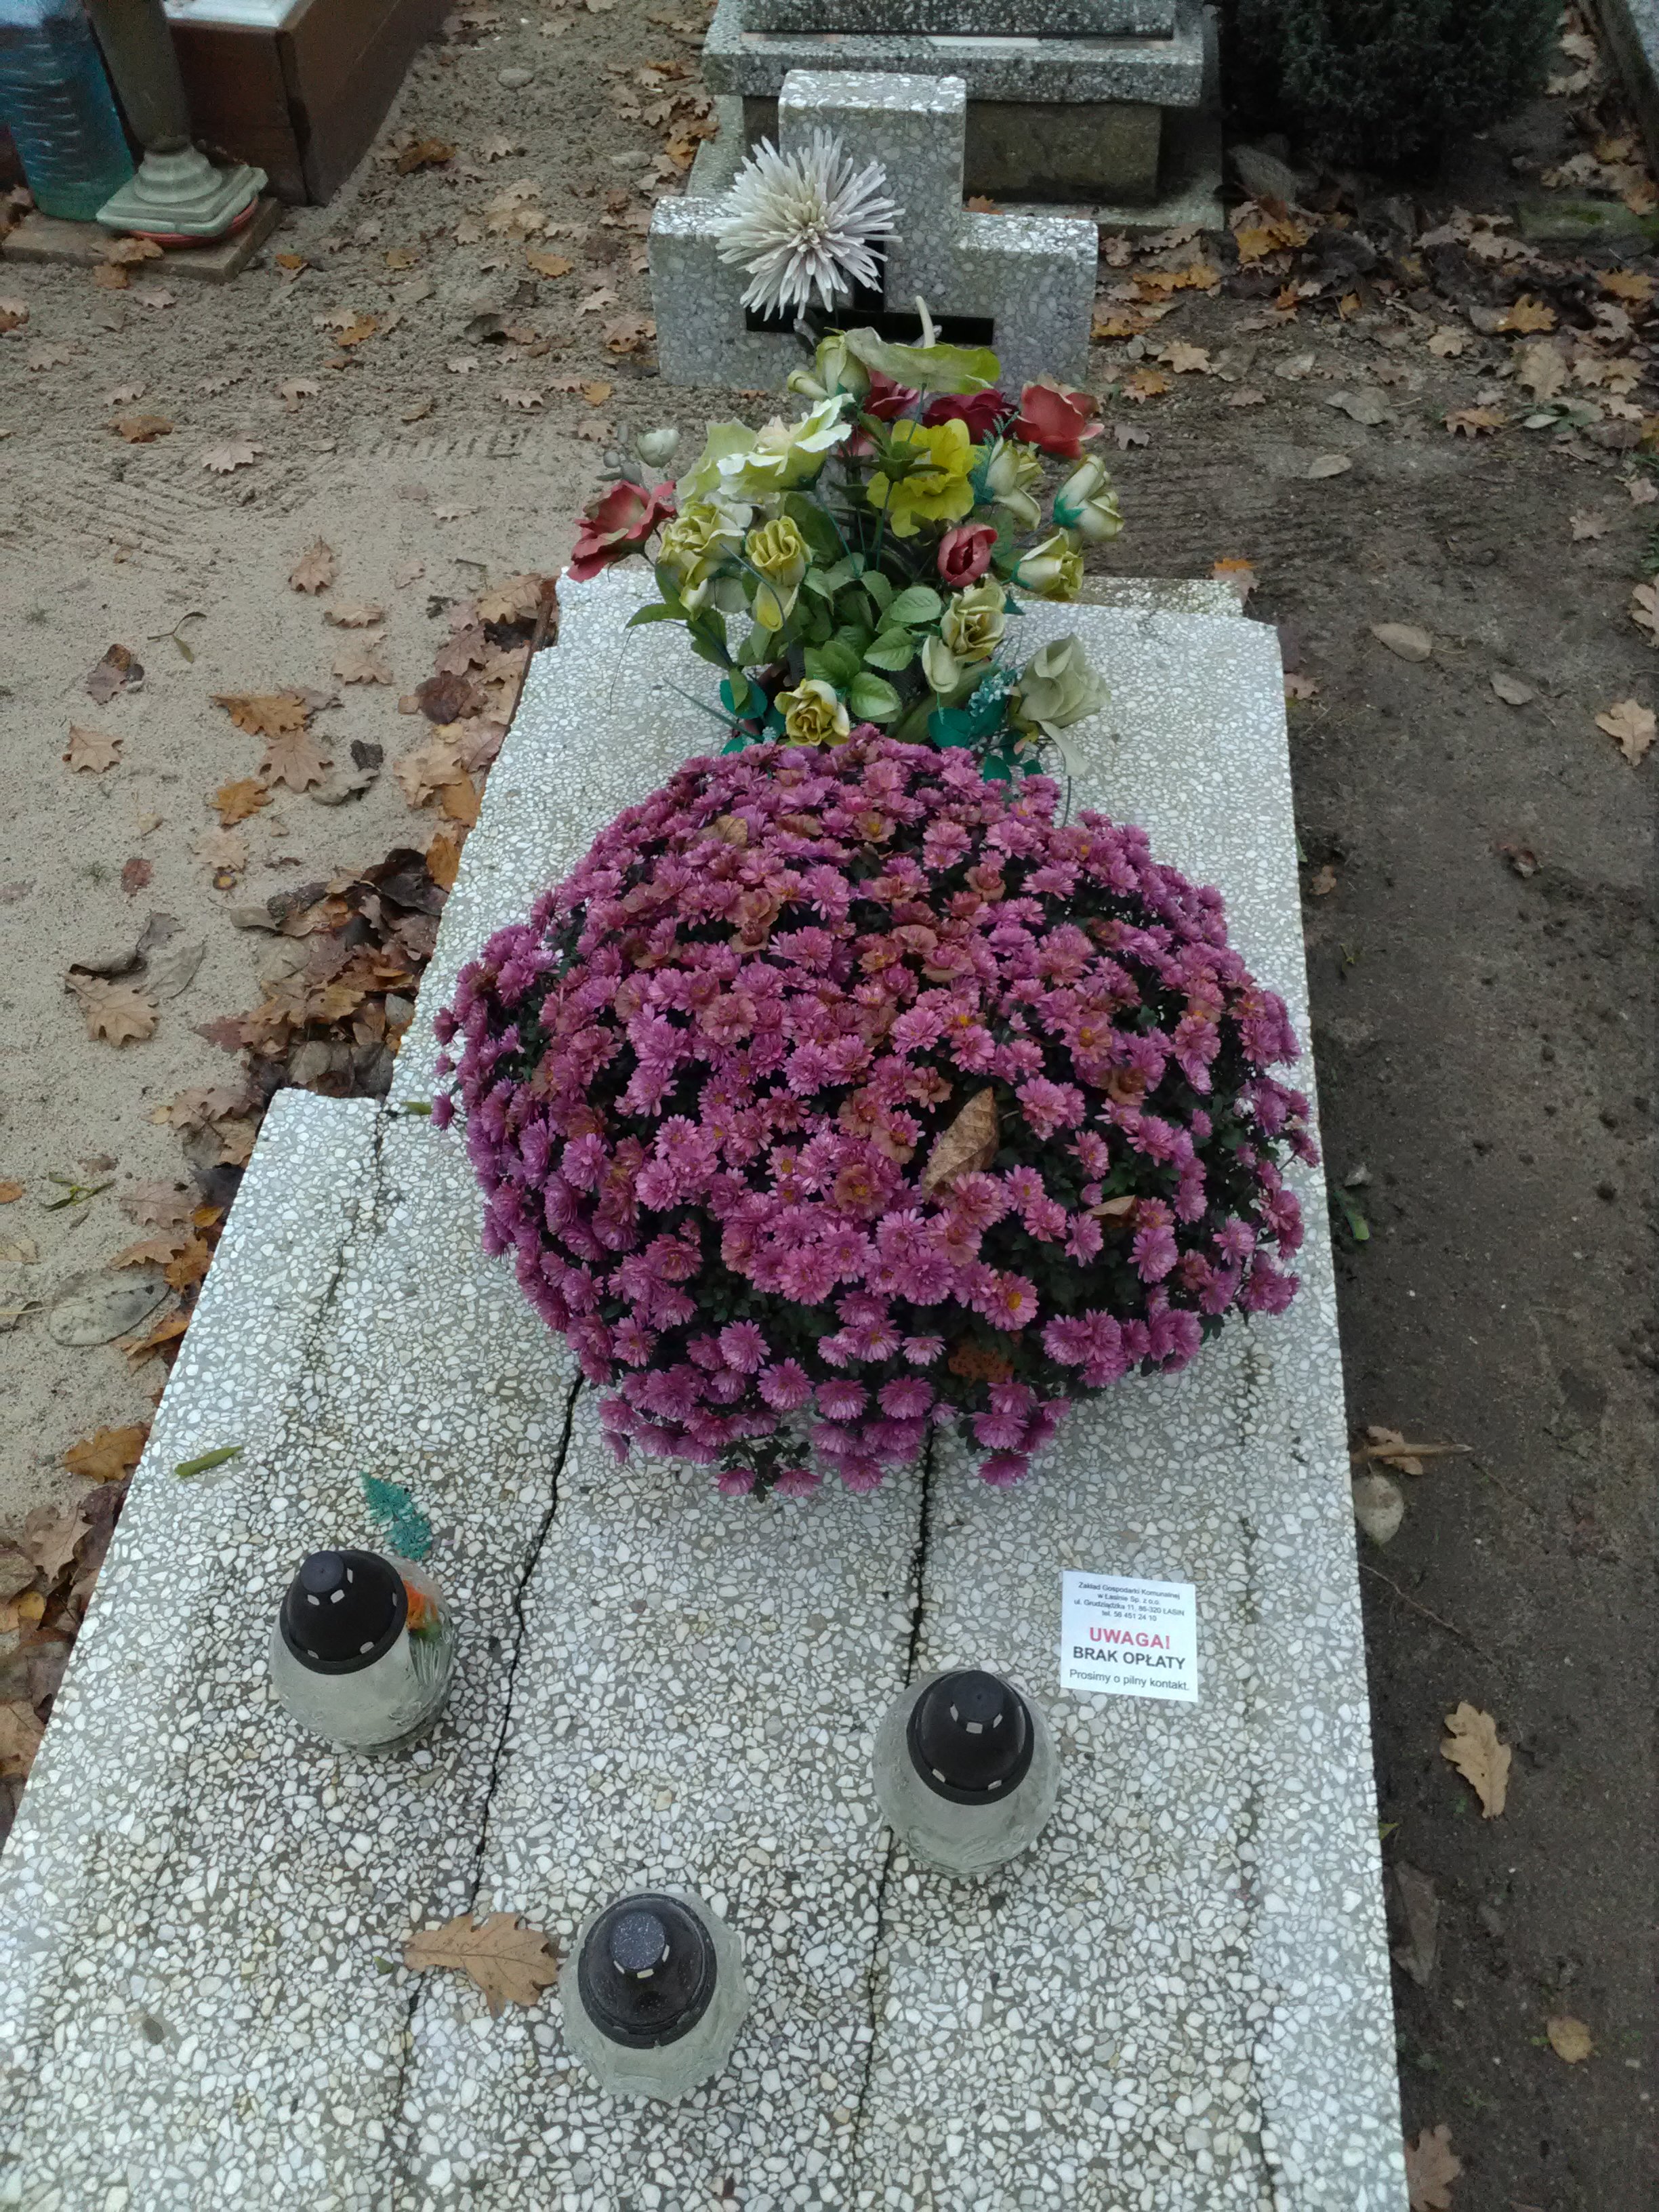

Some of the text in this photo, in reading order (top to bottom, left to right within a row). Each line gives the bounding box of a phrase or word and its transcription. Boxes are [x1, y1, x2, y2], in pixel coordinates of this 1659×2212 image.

[1078, 1582, 1101, 1590] Zakład
[1103, 1584, 1140, 1594] Gospodarki
[1084, 1599, 1125, 1610] Grudziądzka
[1090, 1627, 1170, 1649] UWAGA!
[1073, 1646, 1185, 1670] BRAK OPŁATY
[1070, 1669, 1111, 1684] Prosimy
[1123, 1675, 1147, 1688] pilny
